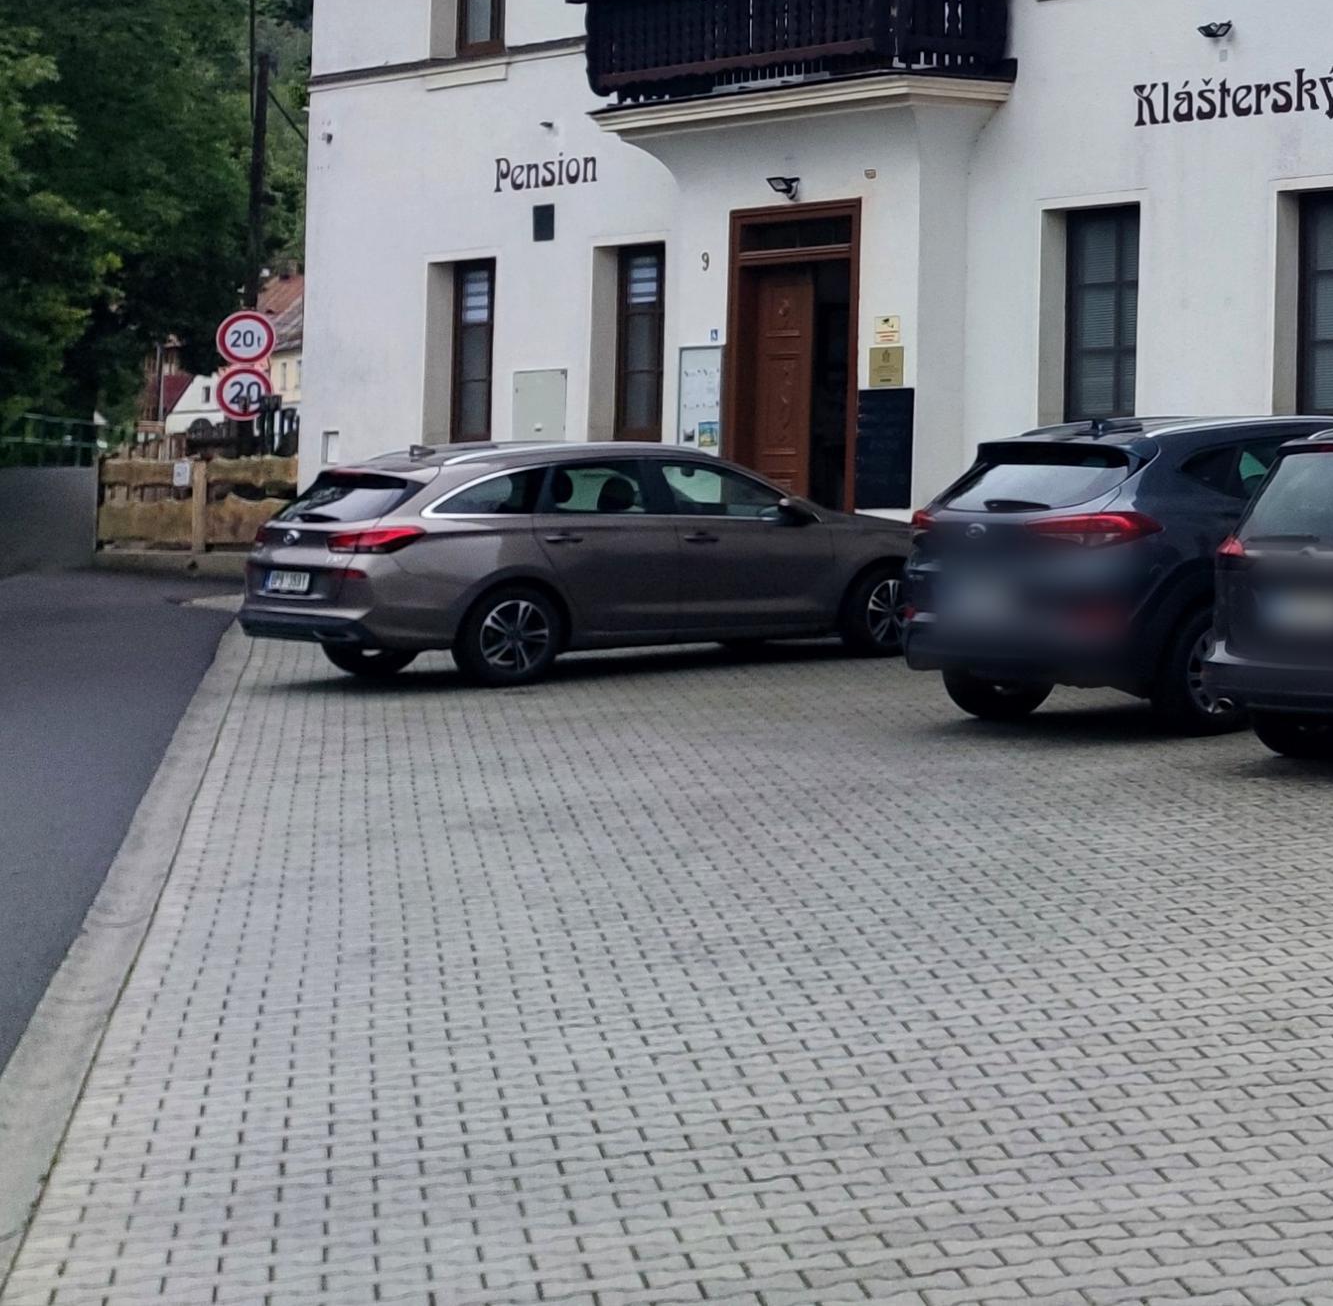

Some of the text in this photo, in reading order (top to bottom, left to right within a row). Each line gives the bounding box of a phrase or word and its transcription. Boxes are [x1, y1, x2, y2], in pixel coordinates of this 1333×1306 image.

[494, 151, 598, 193] Pension
[701, 251, 711, 272] 9
[228, 380, 261, 406] 20
